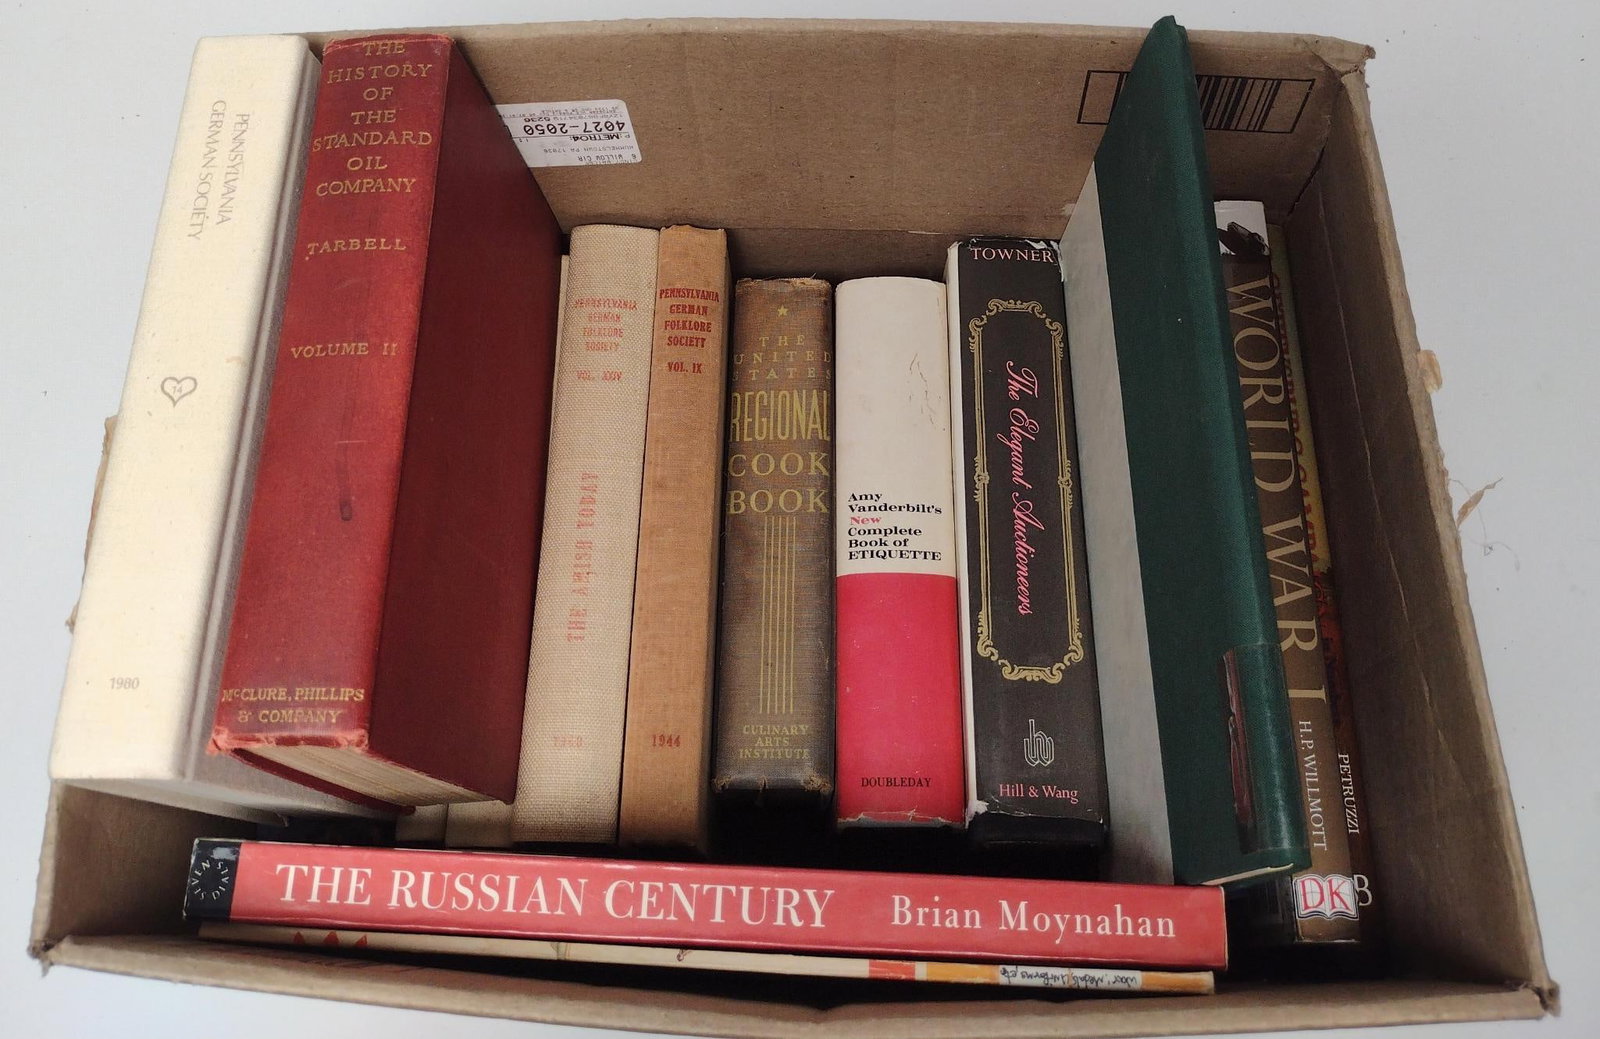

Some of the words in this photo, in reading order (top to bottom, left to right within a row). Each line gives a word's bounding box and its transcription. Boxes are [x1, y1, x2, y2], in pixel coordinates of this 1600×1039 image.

[362, 40, 406, 56] THE
[327, 64, 432, 84] HISTORY
[363, 87, 394, 101] OF
[351, 109, 397, 125] THE
[201, 100, 227, 168] GERMAN
[523, 120, 626, 136] 4027-2050
[312, 131, 433, 152] STANDARD
[347, 156, 388, 171] OIL
[595, 153, 623, 161] WILLOW
[215, 113, 250, 225] PENNSYLVANIA
[316, 178, 416, 196] COMPANY
[187, 172, 213, 240] SOCIETY
[307, 238, 407, 255] TARBELL
[970, 246, 1056, 264] TOWNER
[659, 287, 720, 302] PENNSYLVANIA
[669, 304, 708, 316] GERMAN
[664, 320, 712, 333] FOLKLORE
[666, 336, 707, 348] SOCIETY
[759, 334, 806, 347] THE
[291, 342, 369, 359] VOLUME
[382, 342, 399, 356] II
[733, 351, 831, 365] UNITED
[667, 361, 688, 373] VOL.
[692, 362, 702, 374] IX
[732, 367, 831, 382] STATES
[1006, 360, 1039, 401] The
[730, 389, 831, 442] REGIONAL
[996, 407, 1040, 490] Elegant
[729, 451, 830, 478] COOK
[728, 488, 829, 515] BOOK
[848, 492, 882, 502] Amy
[848, 503, 942, 514] Vanderbilt's
[850, 516, 881, 525] New
[847, 526, 922, 537] Complete
[848, 538, 889, 548] Book
[893, 538, 909, 547] of
[848, 549, 942, 561] ETIQUETTE
[1011, 491, 1045, 616] Auctioneers
[1262, 513, 1319, 654] WAR
[109, 677, 140, 690] 1980
[294, 688, 364, 701] PHILLIPS
[1288, 684, 1327, 706] I
[238, 711, 252, 723] &
[258, 709, 343, 723] COMPANY
[742, 724, 810, 736] CULINARY
[651, 734, 681, 748] 1944
[754, 736, 790, 747] ARTS
[738, 748, 810, 760] INSTITUTE
[860, 776, 933, 788] DOUBLEDAY
[999, 783, 1025, 798] Hill
[1028, 785, 1039, 798] &
[1041, 785, 1079, 805] Wang
[1338, 752, 1360, 835] PETRUZZI
[1303, 754, 1328, 852] WILLMOTT
[276, 863, 373, 906] THE
[388, 869, 588, 916] RUSSIAN
[604, 878, 836, 929] CENTURY
[1300, 877, 1353, 912] DK
[891, 894, 982, 931] Brian
[998, 899, 1177, 945] Moynahan
